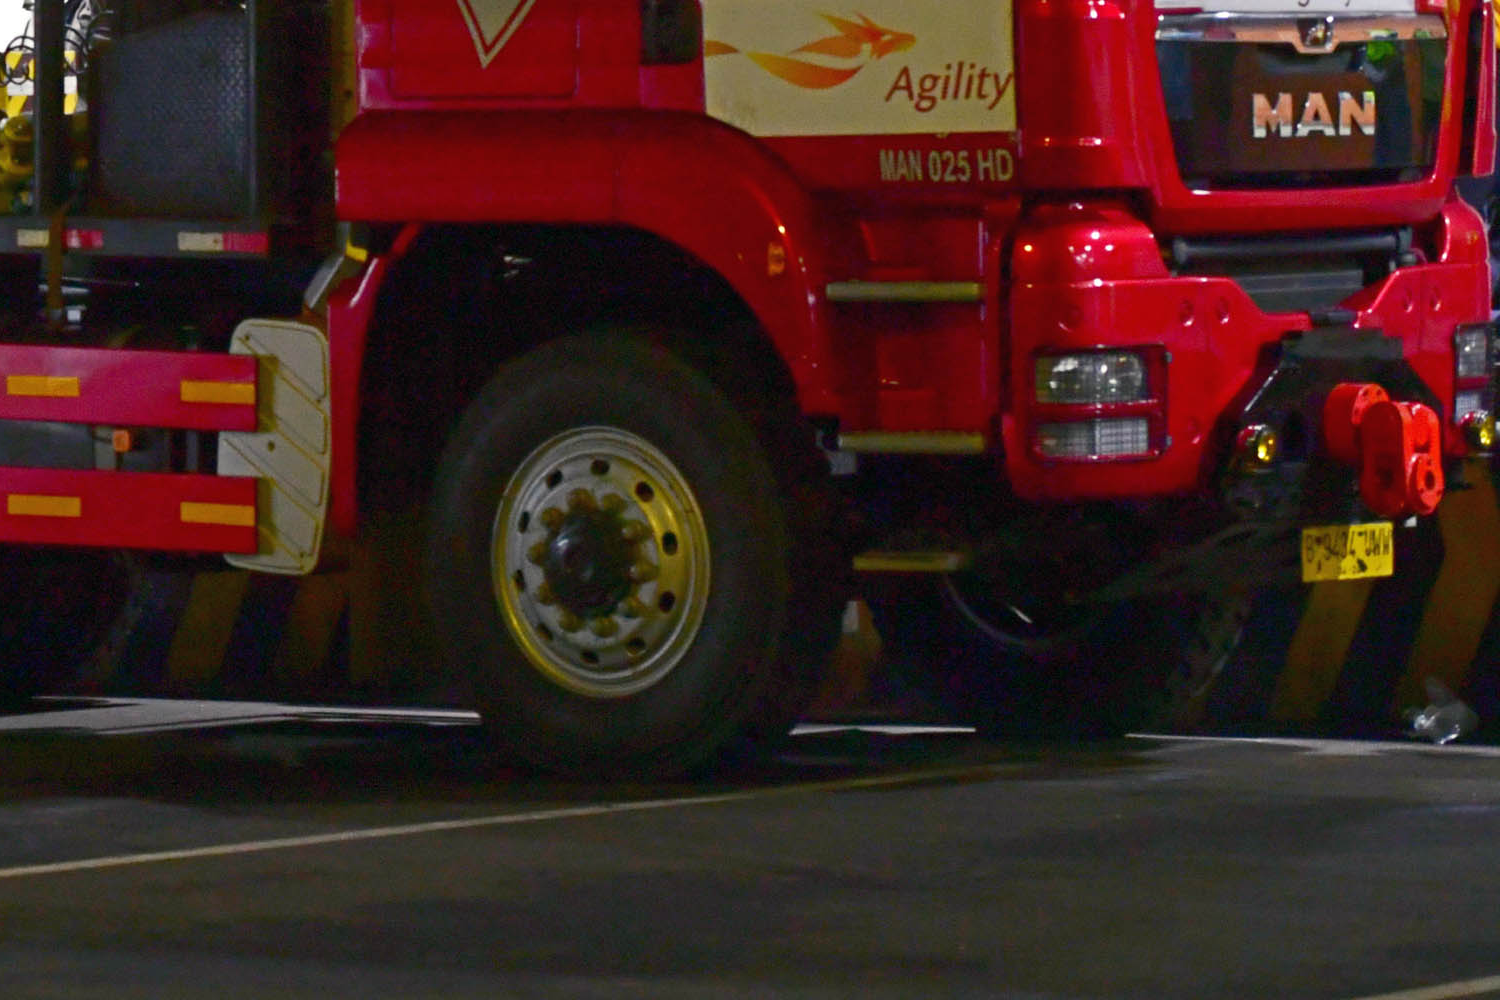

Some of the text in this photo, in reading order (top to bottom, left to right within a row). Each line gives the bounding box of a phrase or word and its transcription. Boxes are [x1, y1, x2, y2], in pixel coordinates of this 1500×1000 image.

[885, 61, 1014, 112] Agility
[1253, 91, 1376, 138] MAN
[880, 149, 1013, 182] MAN 025 HD
